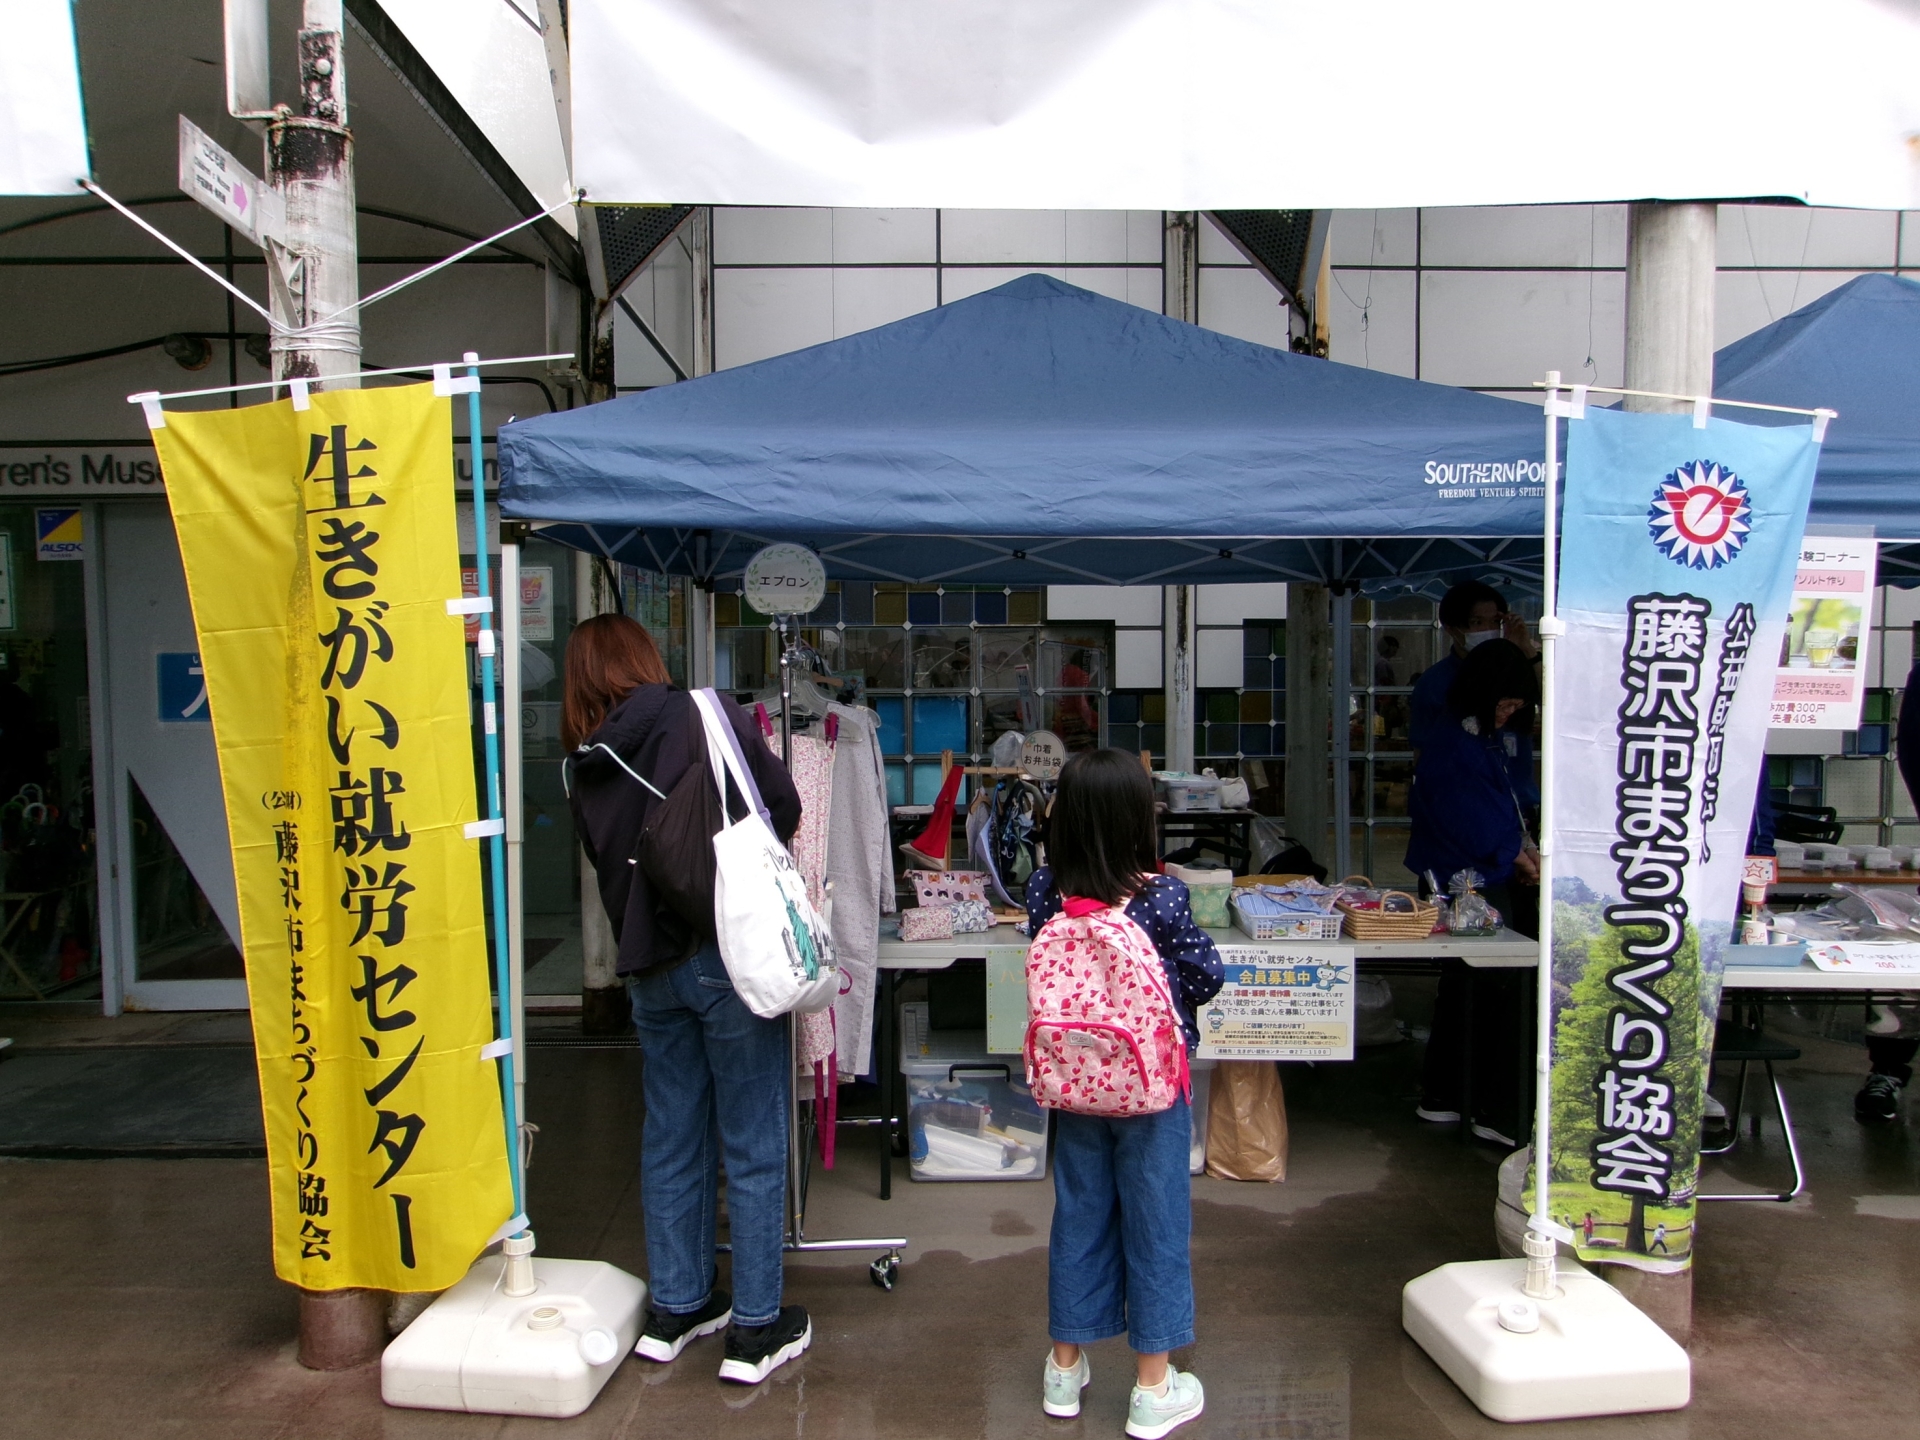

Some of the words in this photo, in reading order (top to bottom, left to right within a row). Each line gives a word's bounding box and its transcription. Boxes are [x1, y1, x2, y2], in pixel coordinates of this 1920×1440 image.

[81, 454, 164, 486] Mus
[1438, 487, 1476, 499] FREEDOM
[1480, 487, 1516, 498] VENTURE
[40, 543, 83, 552] ALSOK
[759, 575, 810, 588] エプロン
[1794, 574, 1846, 586] ソルト作り
[1771, 713, 1817, 724] 先着40名
[1033, 743, 1052, 754] 巾着
[1023, 755, 1062, 768] お弁当袋
[303, 424, 427, 1269] 生きがい就労センター
[1590, 593, 1710, 1199] 藤沢市まちづくり協会
[1229, 954, 1323, 965] 生きがい就労センター
[1239, 969, 1311, 985] 会員募集中
